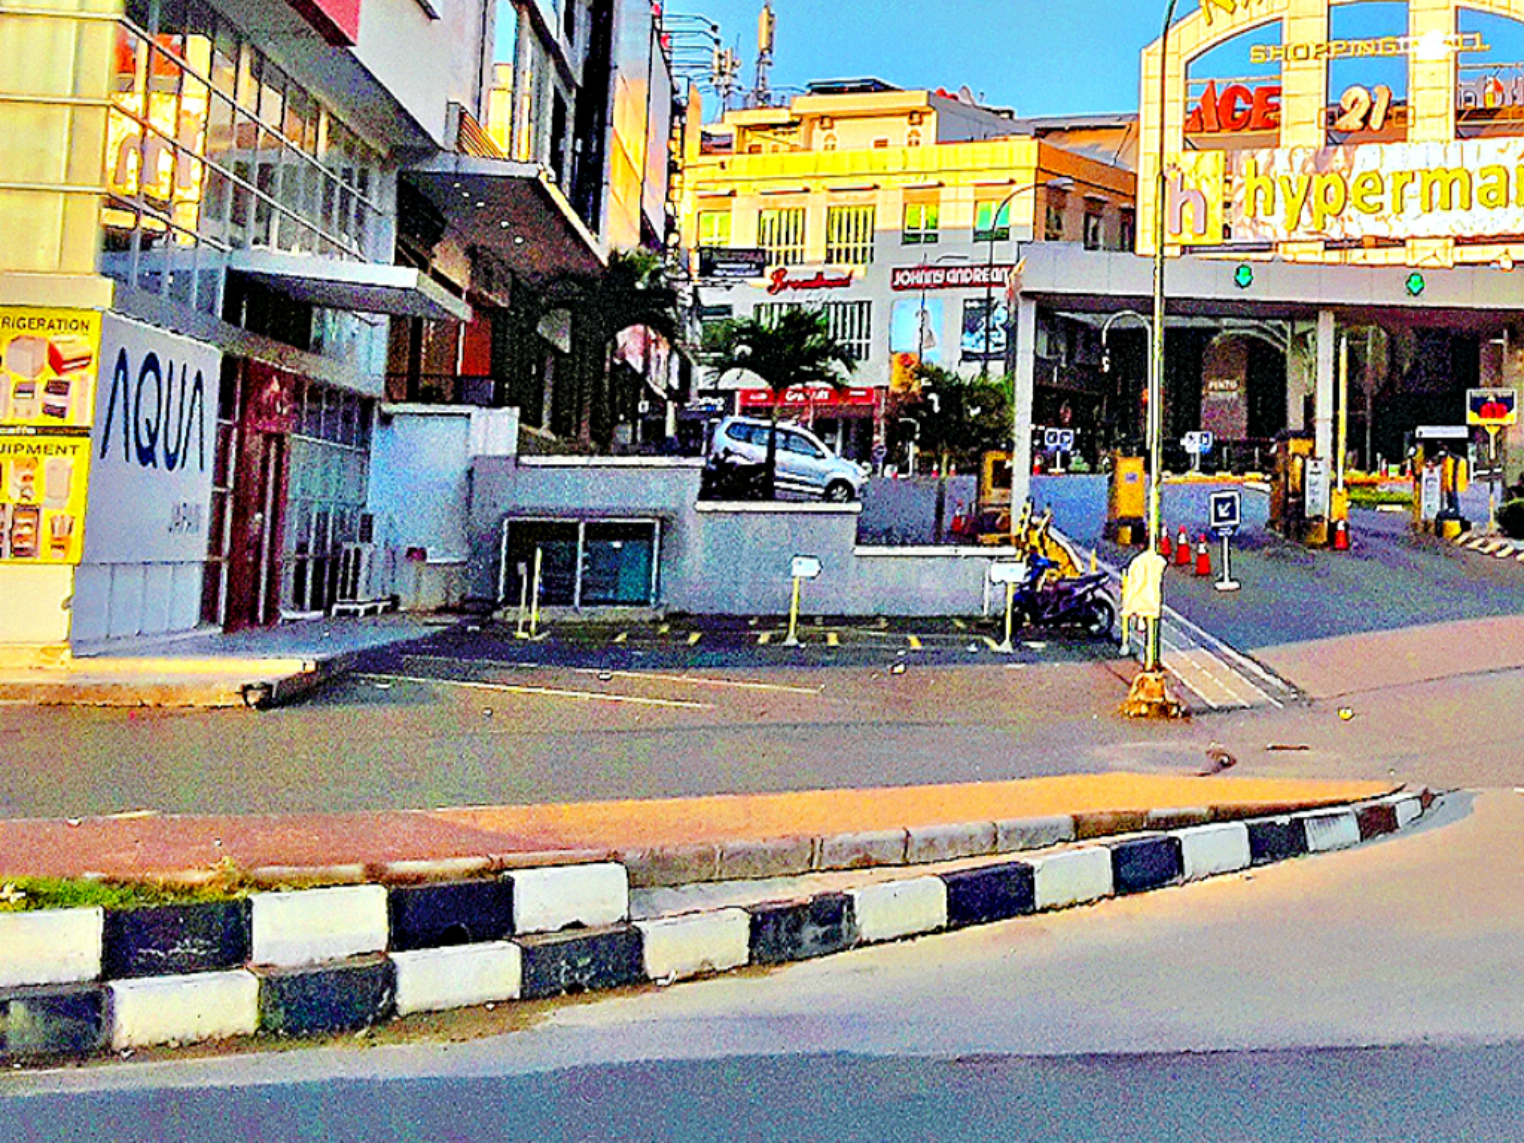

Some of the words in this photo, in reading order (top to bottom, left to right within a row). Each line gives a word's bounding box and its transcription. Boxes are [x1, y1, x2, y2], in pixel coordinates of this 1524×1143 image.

[1250, 36, 1398, 63] SHOPPING
[1183, 79, 1282, 132] ACE
[1334, 84, 1393, 132] 21
[893, 268, 944, 285] JOHNNY
[100, 347, 205, 472] AQUA
